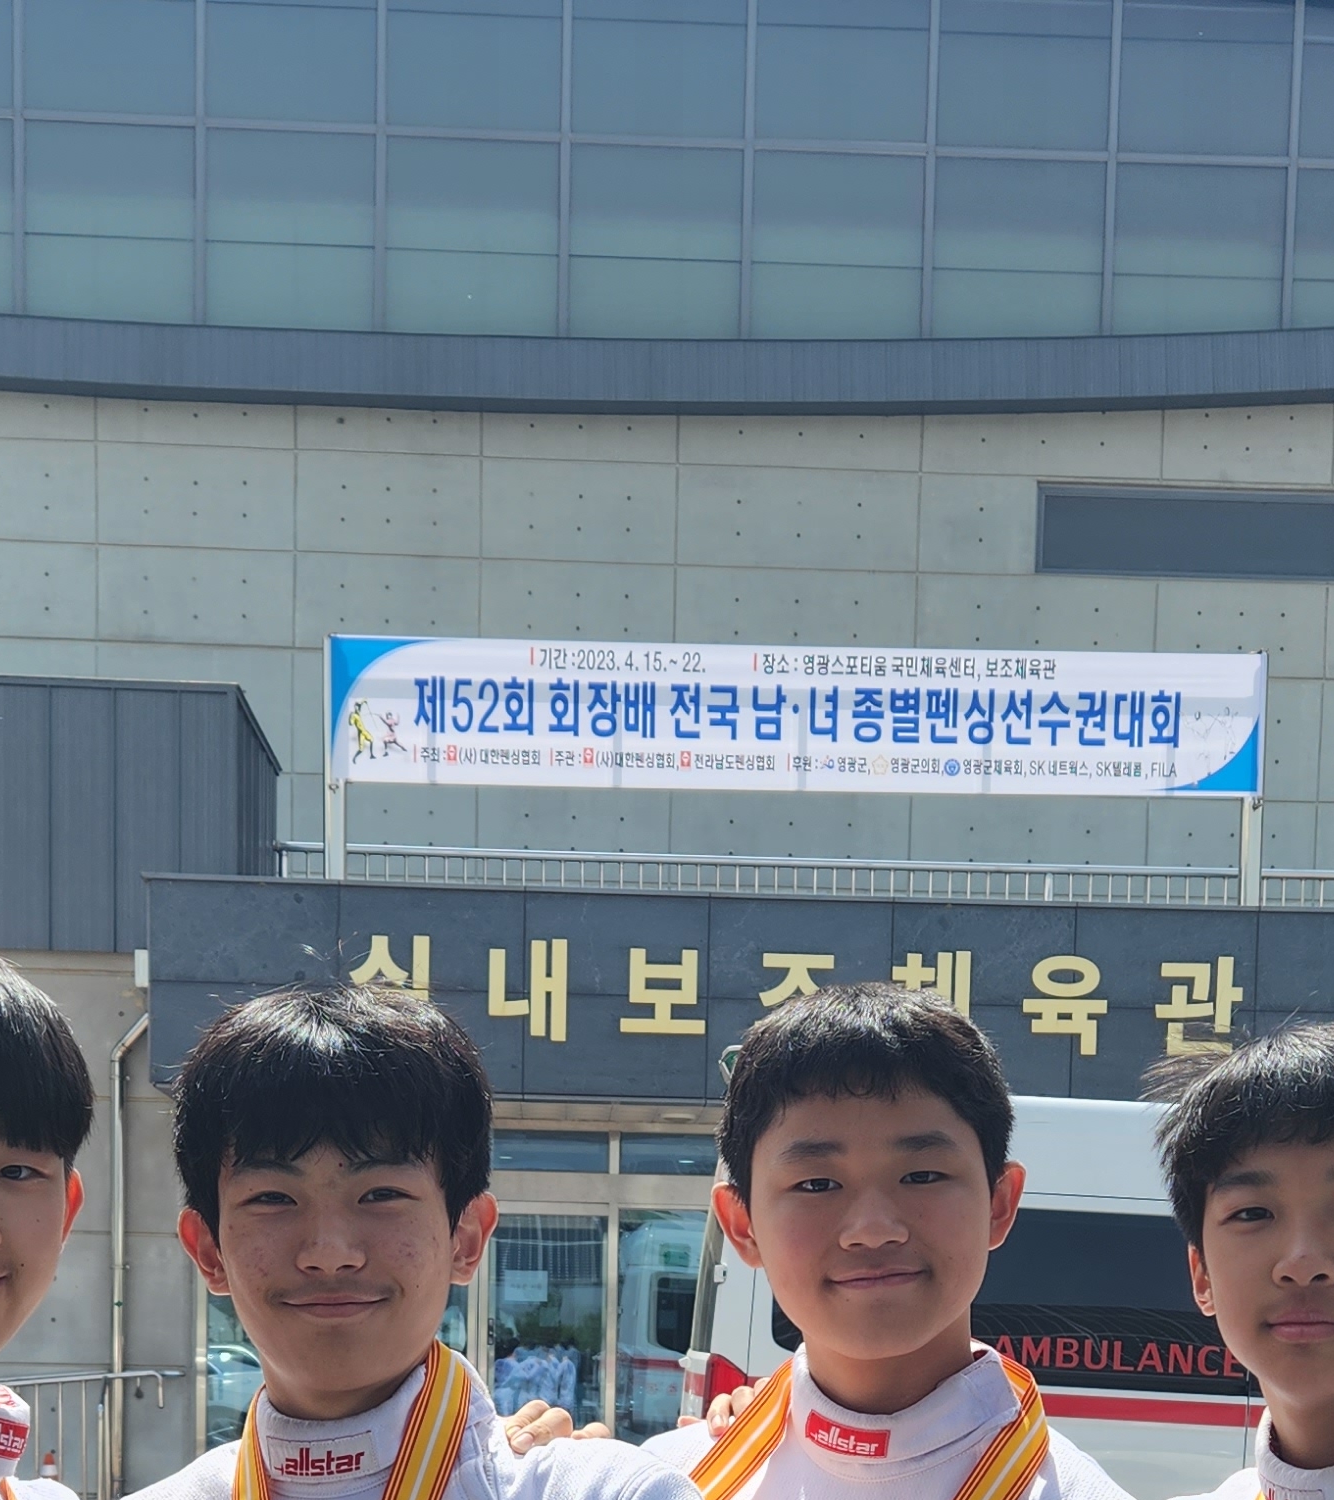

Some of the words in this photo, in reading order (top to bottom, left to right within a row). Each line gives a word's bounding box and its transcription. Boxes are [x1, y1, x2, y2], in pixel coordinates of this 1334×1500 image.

[539, 648, 567, 670] 기간
[762, 653, 790, 676] 장소
[802, 654, 887, 677] 영광스포티움
[891, 656, 982, 681] 국민체육센터,
[985, 657, 1057, 680] 보조체육관
[413, 675, 535, 735] 제52회
[548, 677, 657, 739] 회장배
[670, 682, 740, 741] 전국
[852, 687, 1181, 748] 종별펜싱선수권대회
[420, 746, 440, 763] 주최
[480, 748, 541, 766] 대한펜싱협회
[554, 750, 575, 767] 주관
[694, 753, 775, 772] 전라남도펜싱협회
[792, 755, 812, 772] 후원
[1151, 761, 1178, 778] FILA
[995, 1334, 1244, 1378] AMBULANCE
[817, 1426, 879, 1456] allstar
[285, 1447, 365, 1477] allstar
